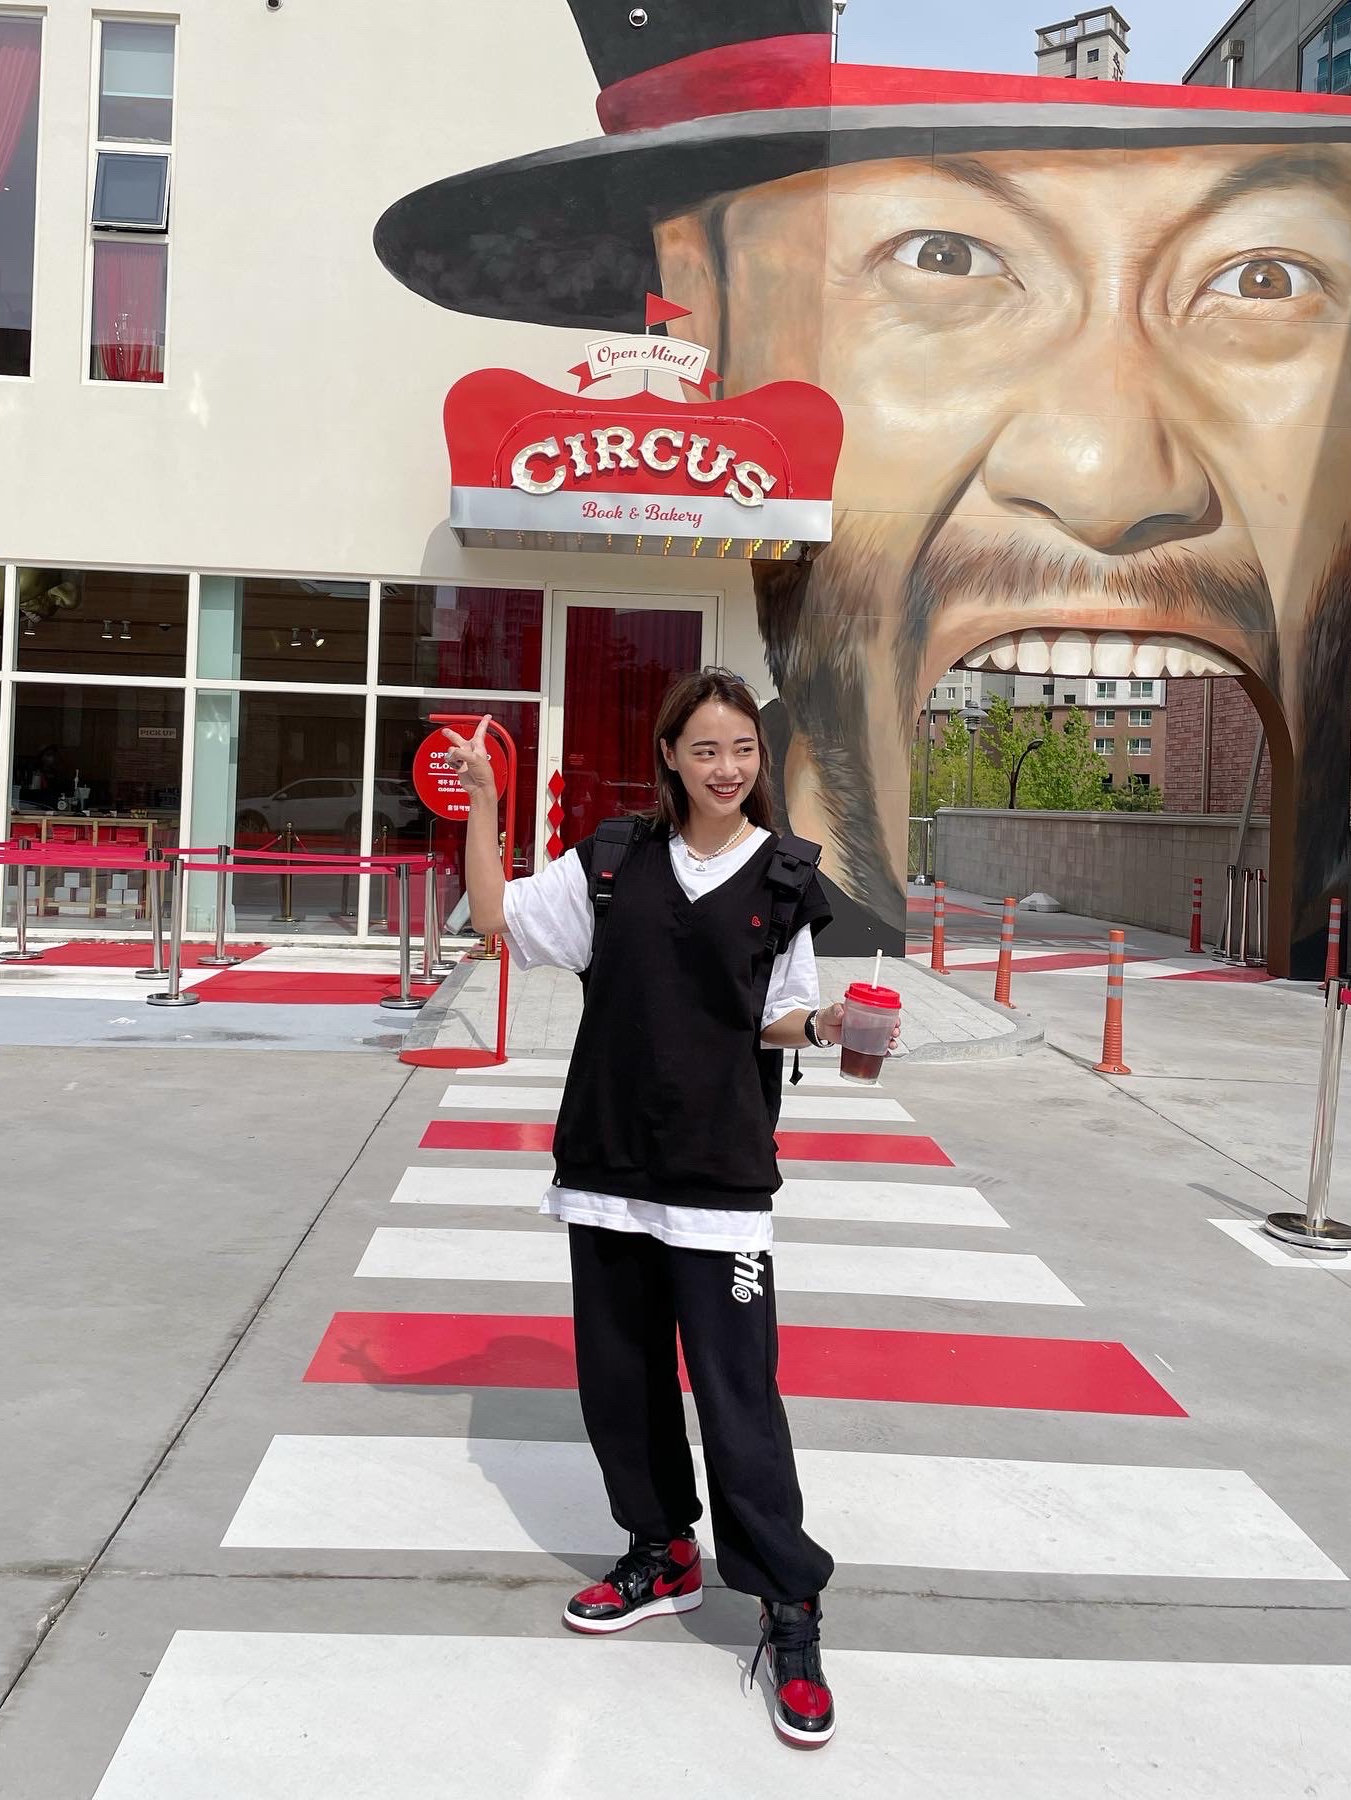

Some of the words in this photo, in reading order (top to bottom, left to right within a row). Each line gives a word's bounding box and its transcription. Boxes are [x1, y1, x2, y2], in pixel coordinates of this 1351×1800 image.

[597, 345, 637, 366] Open
[641, 344, 699, 370] Mind!
[510, 426, 777, 508] CIRCUS
[582, 501, 623, 520] Book
[629, 505, 640, 519] &
[644, 502, 703, 529] Bakery
